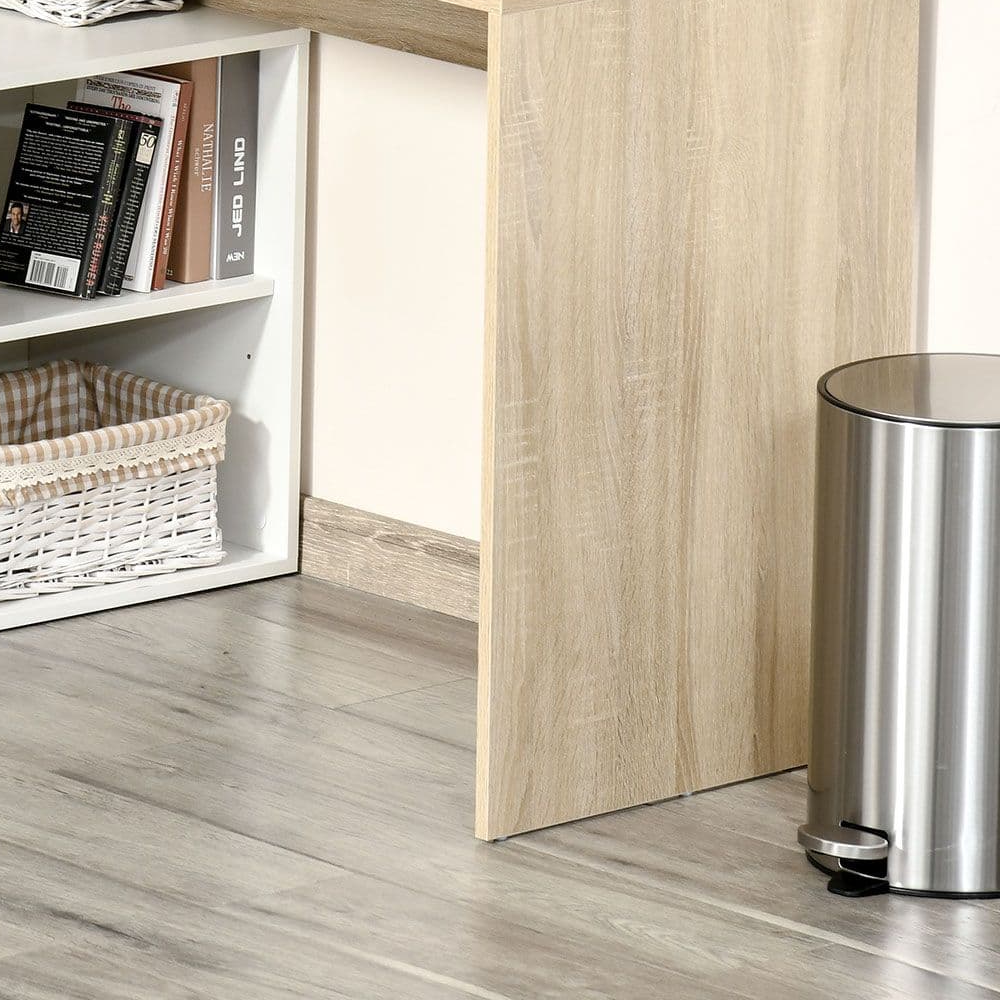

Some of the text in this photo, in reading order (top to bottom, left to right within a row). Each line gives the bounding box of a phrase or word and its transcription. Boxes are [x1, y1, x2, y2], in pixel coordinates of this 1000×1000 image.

[140, 134, 157, 149] 50
[201, 123, 216, 193] NATHALIE
[232, 137, 246, 237] JED LIND
